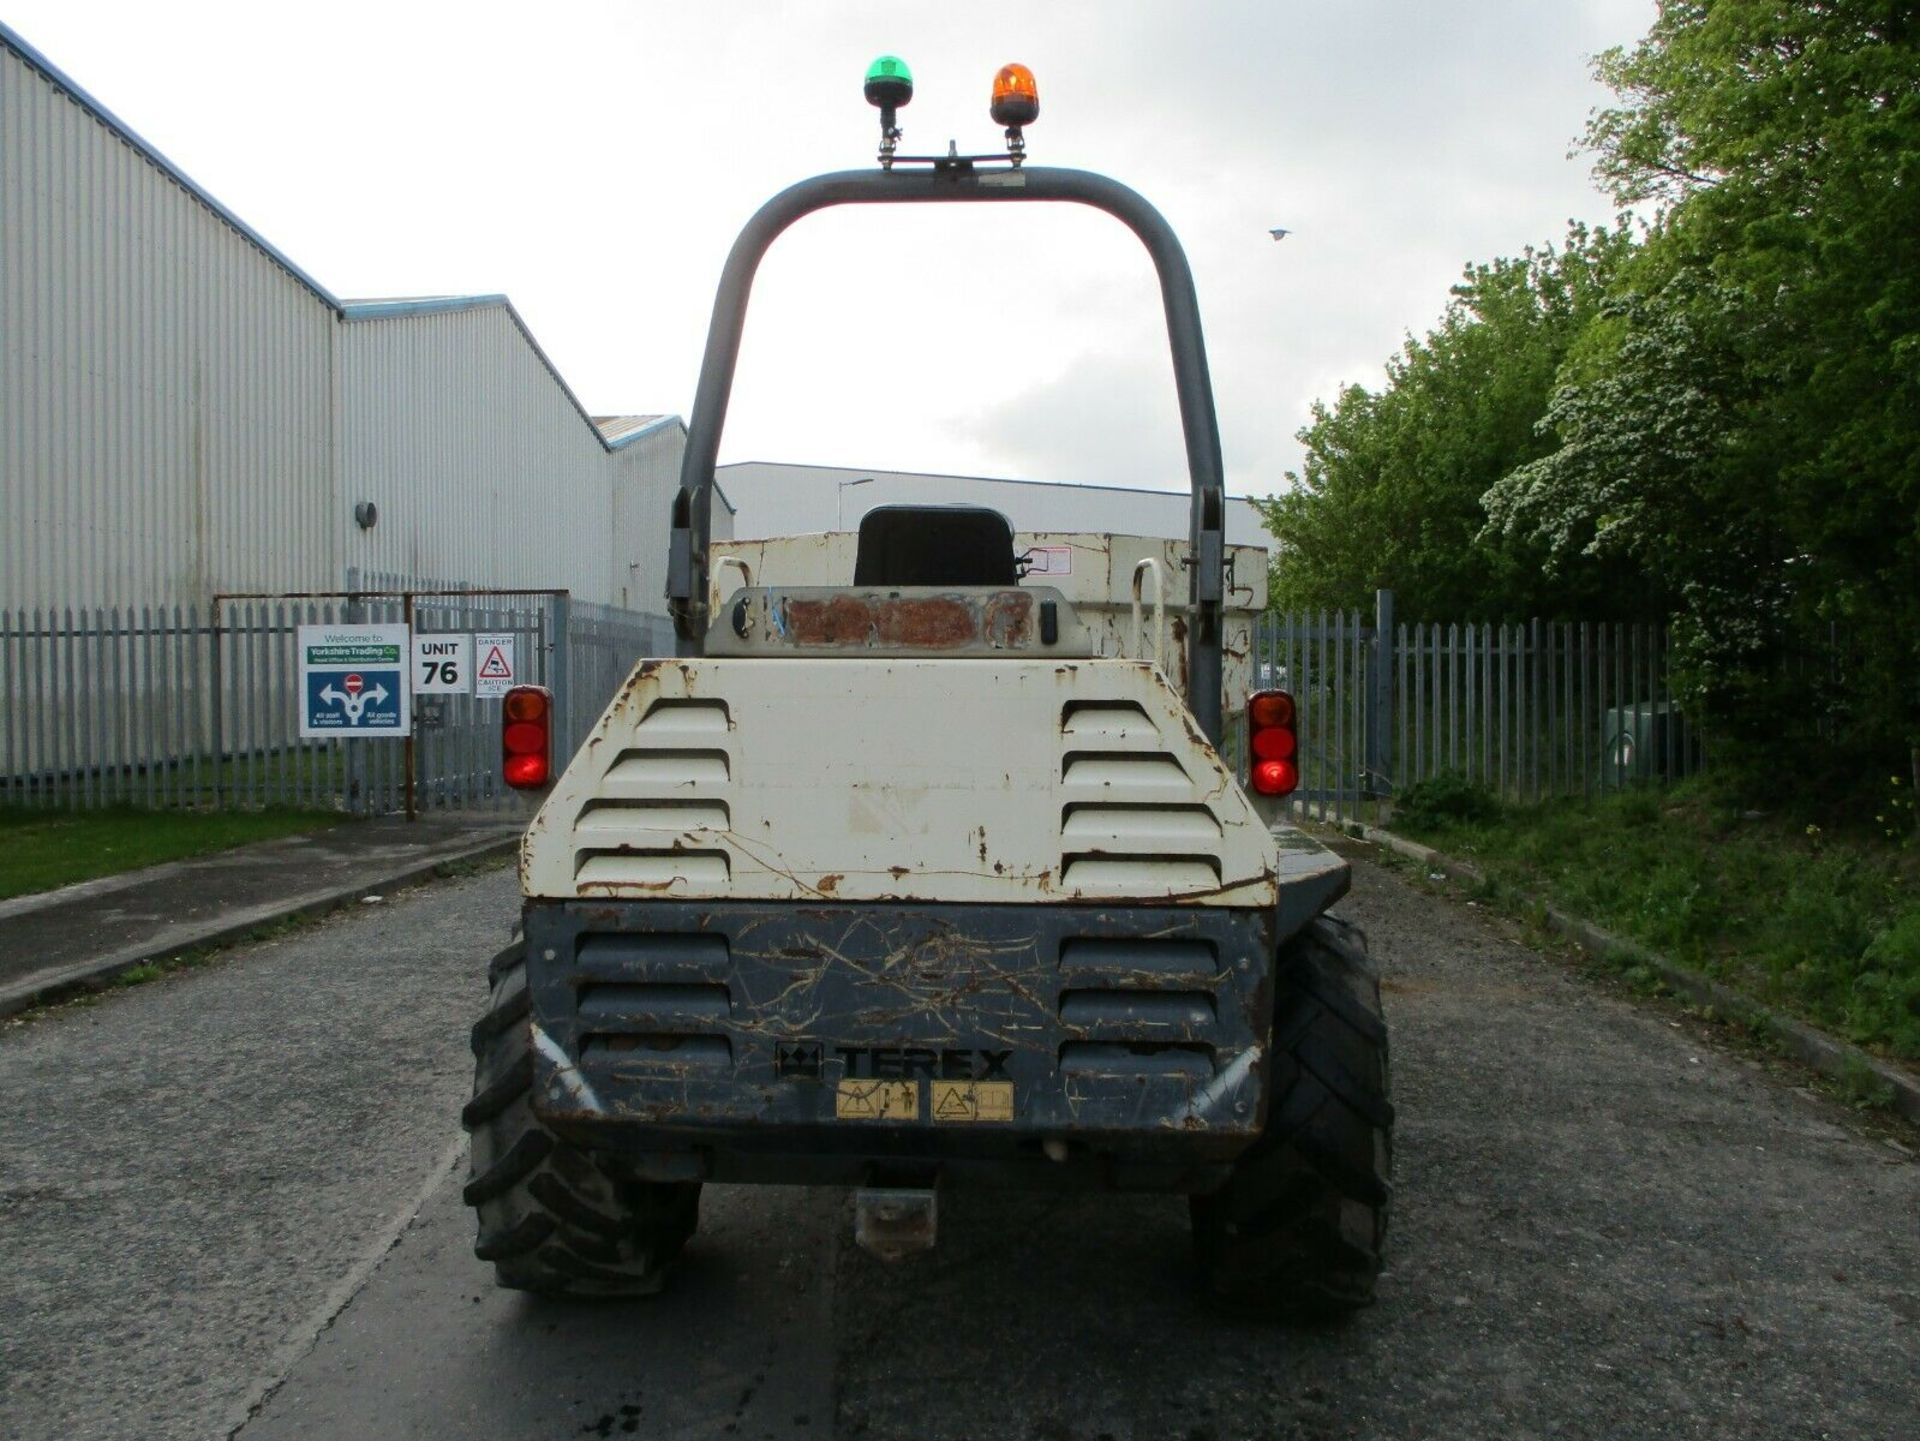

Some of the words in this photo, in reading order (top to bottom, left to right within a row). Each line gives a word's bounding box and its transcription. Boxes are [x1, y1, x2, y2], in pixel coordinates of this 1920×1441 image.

[324, 634, 370, 643] Welcome
[372, 634, 383, 642] to
[311, 647, 350, 656] Yorkshire
[351, 647, 383, 657] Trading
[384, 646, 398, 655] Co.
[422, 643, 459, 655] UNIT
[422, 661, 458, 685] 76
[835, 1048, 1014, 1079] TEREX
